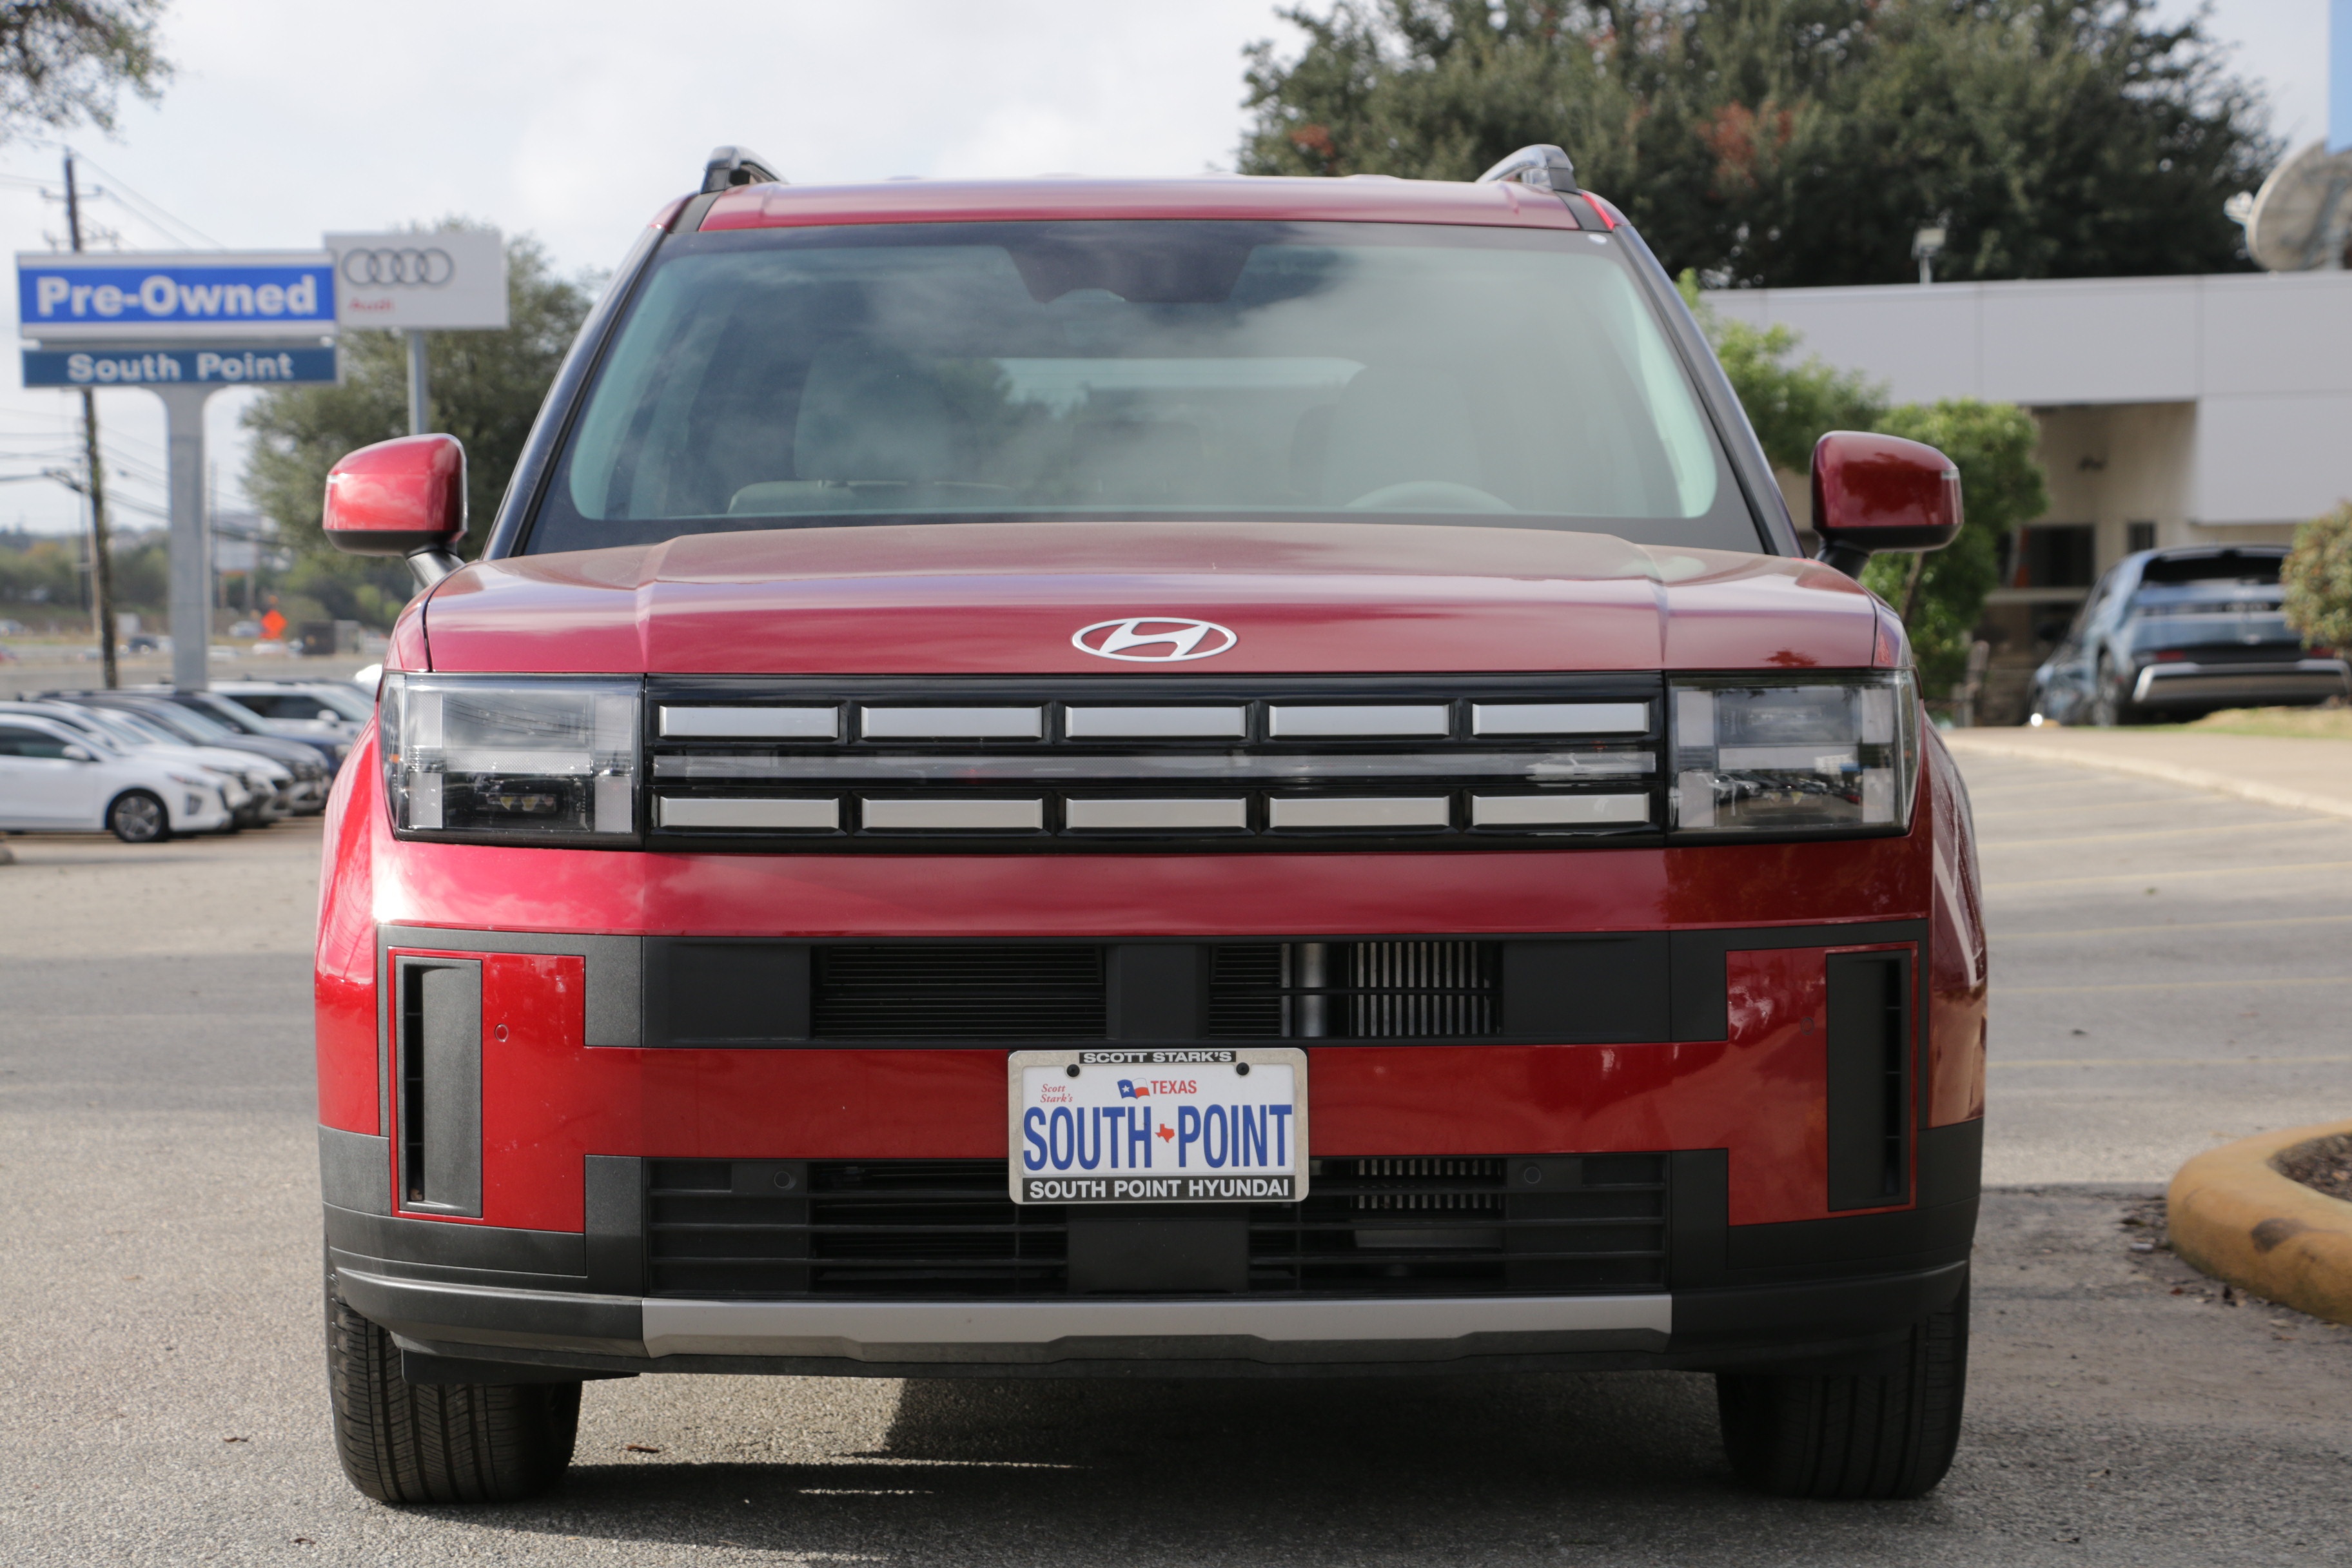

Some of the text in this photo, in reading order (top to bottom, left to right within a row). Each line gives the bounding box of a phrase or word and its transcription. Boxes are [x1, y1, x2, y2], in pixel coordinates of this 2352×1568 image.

[35, 275, 317, 316] Pre-Owned
[67, 351, 293, 382] South Point
[1083, 1051, 1232, 1063] SCOTT STARK'S
[1041, 1084, 1066, 1093] Scott
[1150, 1080, 1197, 1094] TEXAS
[1040, 1093, 1073, 1103] Stark's
[1023, 1104, 1292, 1171] SOUTH POINT
[1030, 1179, 1289, 1199] SOUTH POINT HYUNDAI
